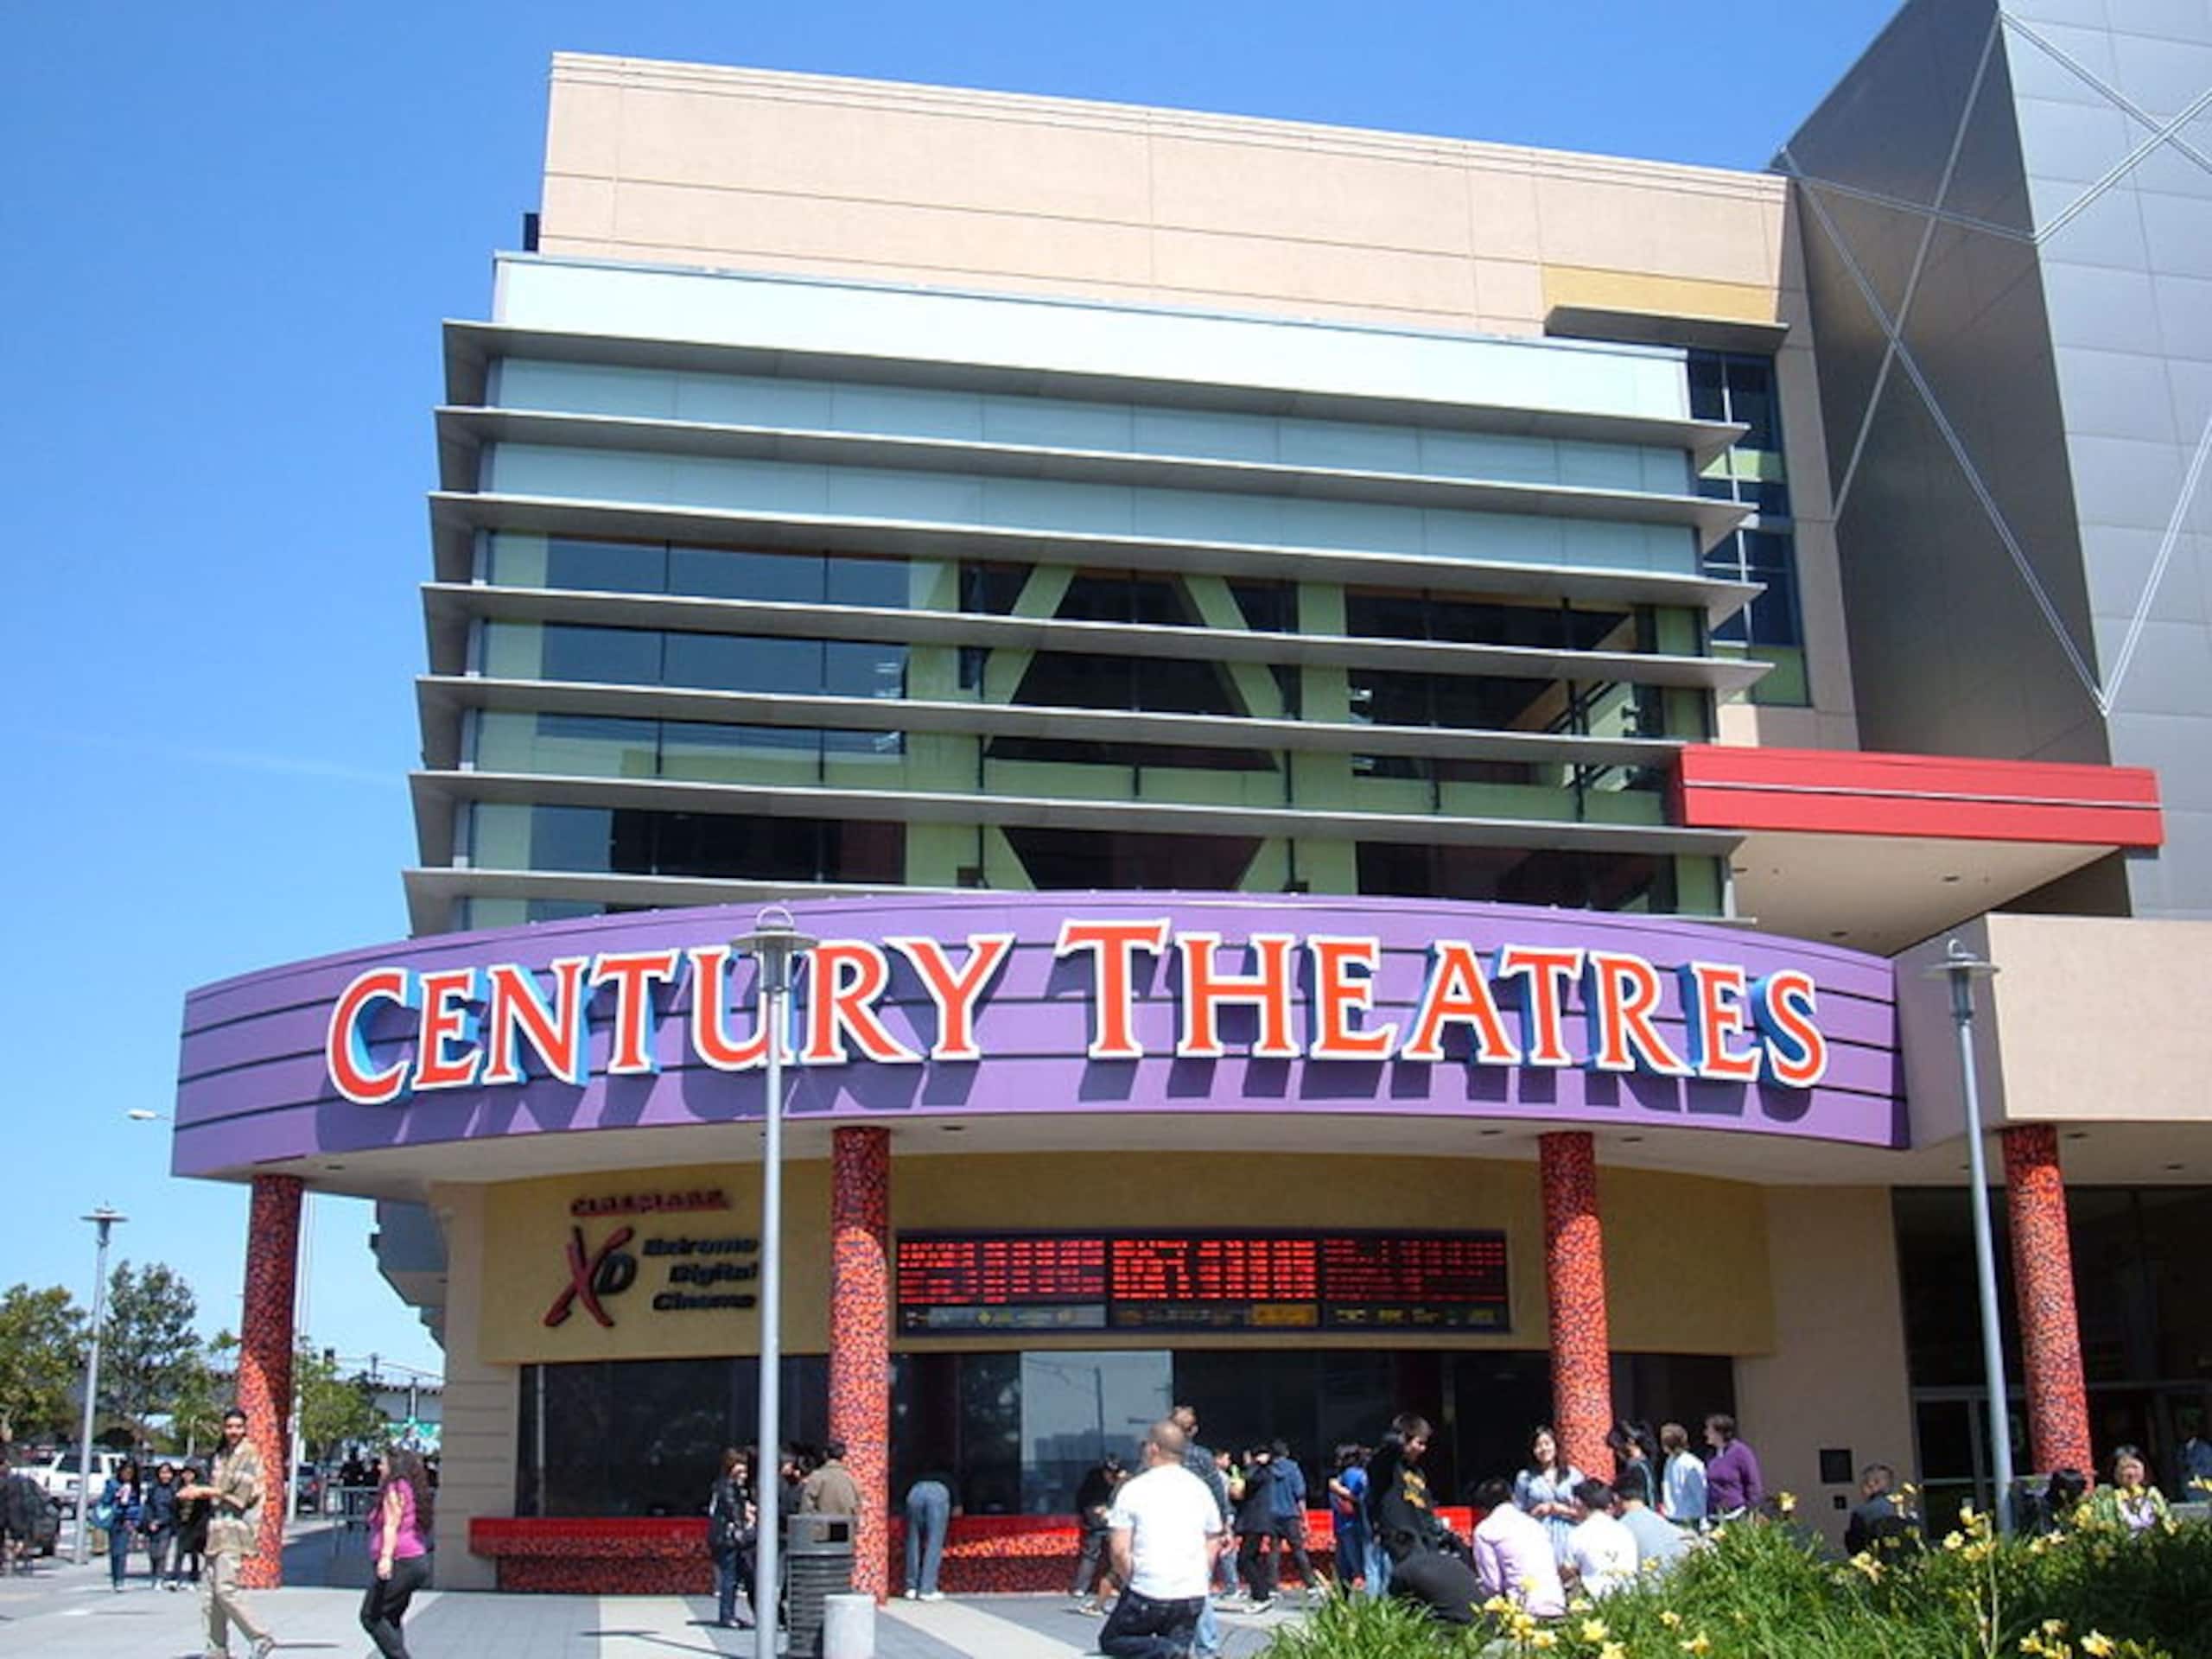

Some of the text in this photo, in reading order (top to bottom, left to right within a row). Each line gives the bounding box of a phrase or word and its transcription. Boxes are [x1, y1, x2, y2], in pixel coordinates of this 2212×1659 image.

[327, 917, 1828, 1106] CENTURY THEATRES
[669, 1261, 759, 1287] Digital
